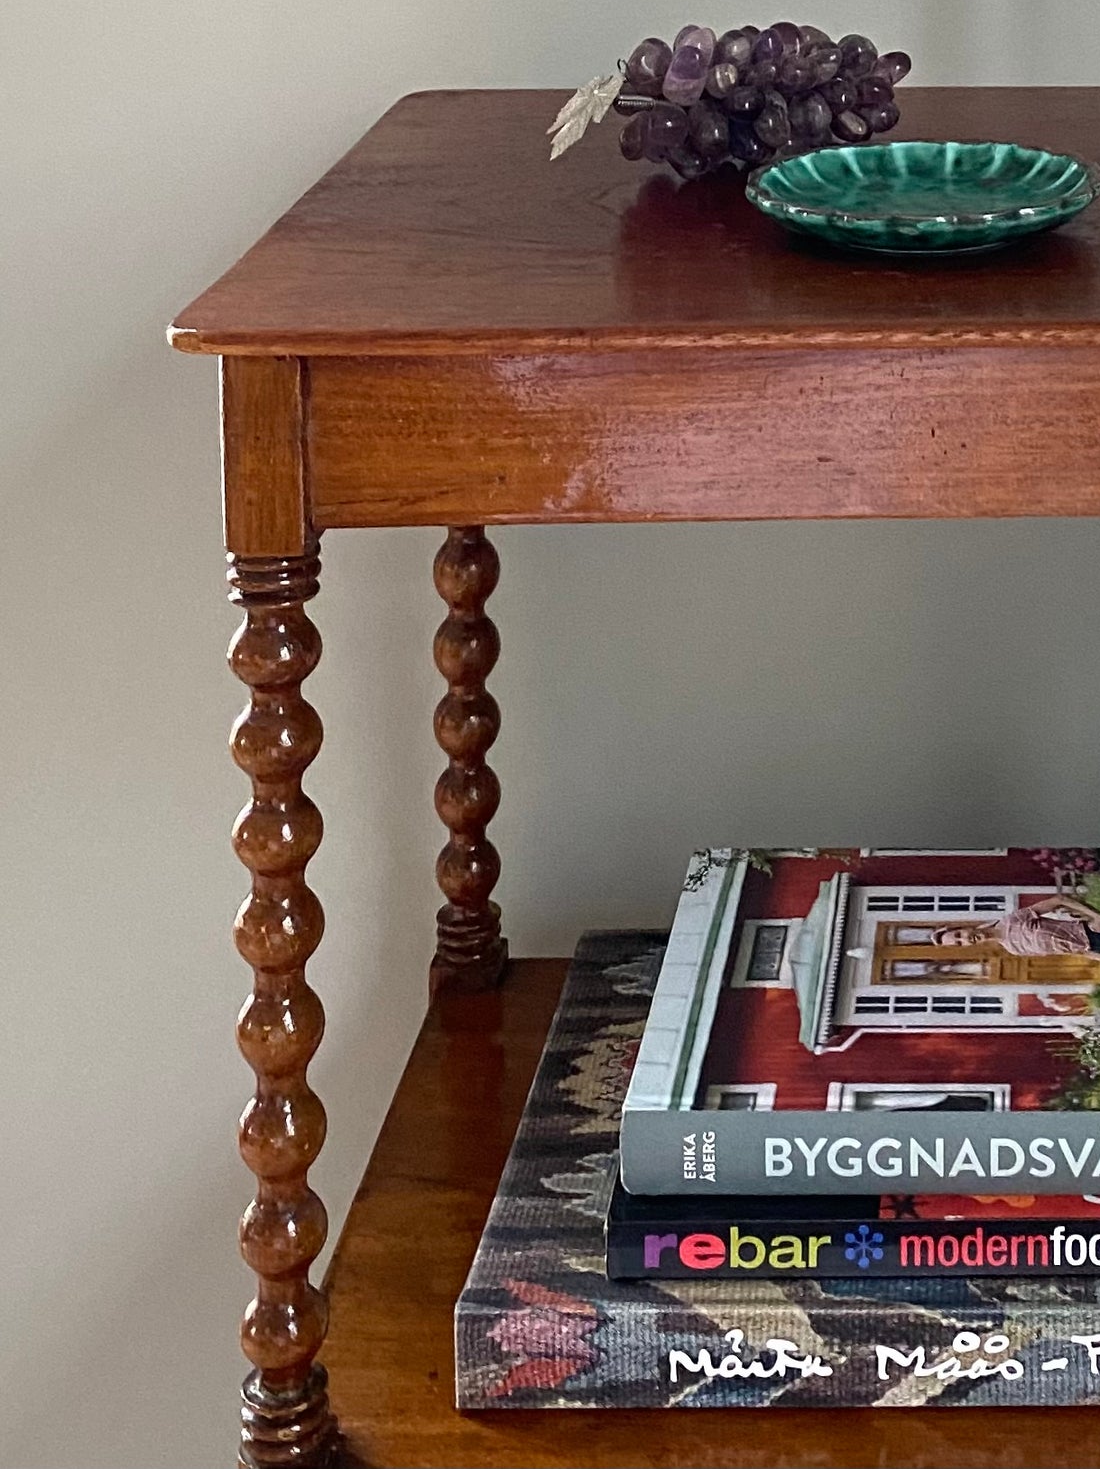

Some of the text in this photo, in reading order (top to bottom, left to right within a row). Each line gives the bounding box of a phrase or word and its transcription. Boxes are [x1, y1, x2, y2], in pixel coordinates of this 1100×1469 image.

[683, 1133, 697, 1180] ERIKA
[698, 1130, 716, 1183] ÅBERG
[643, 1226, 832, 1270] rebar
